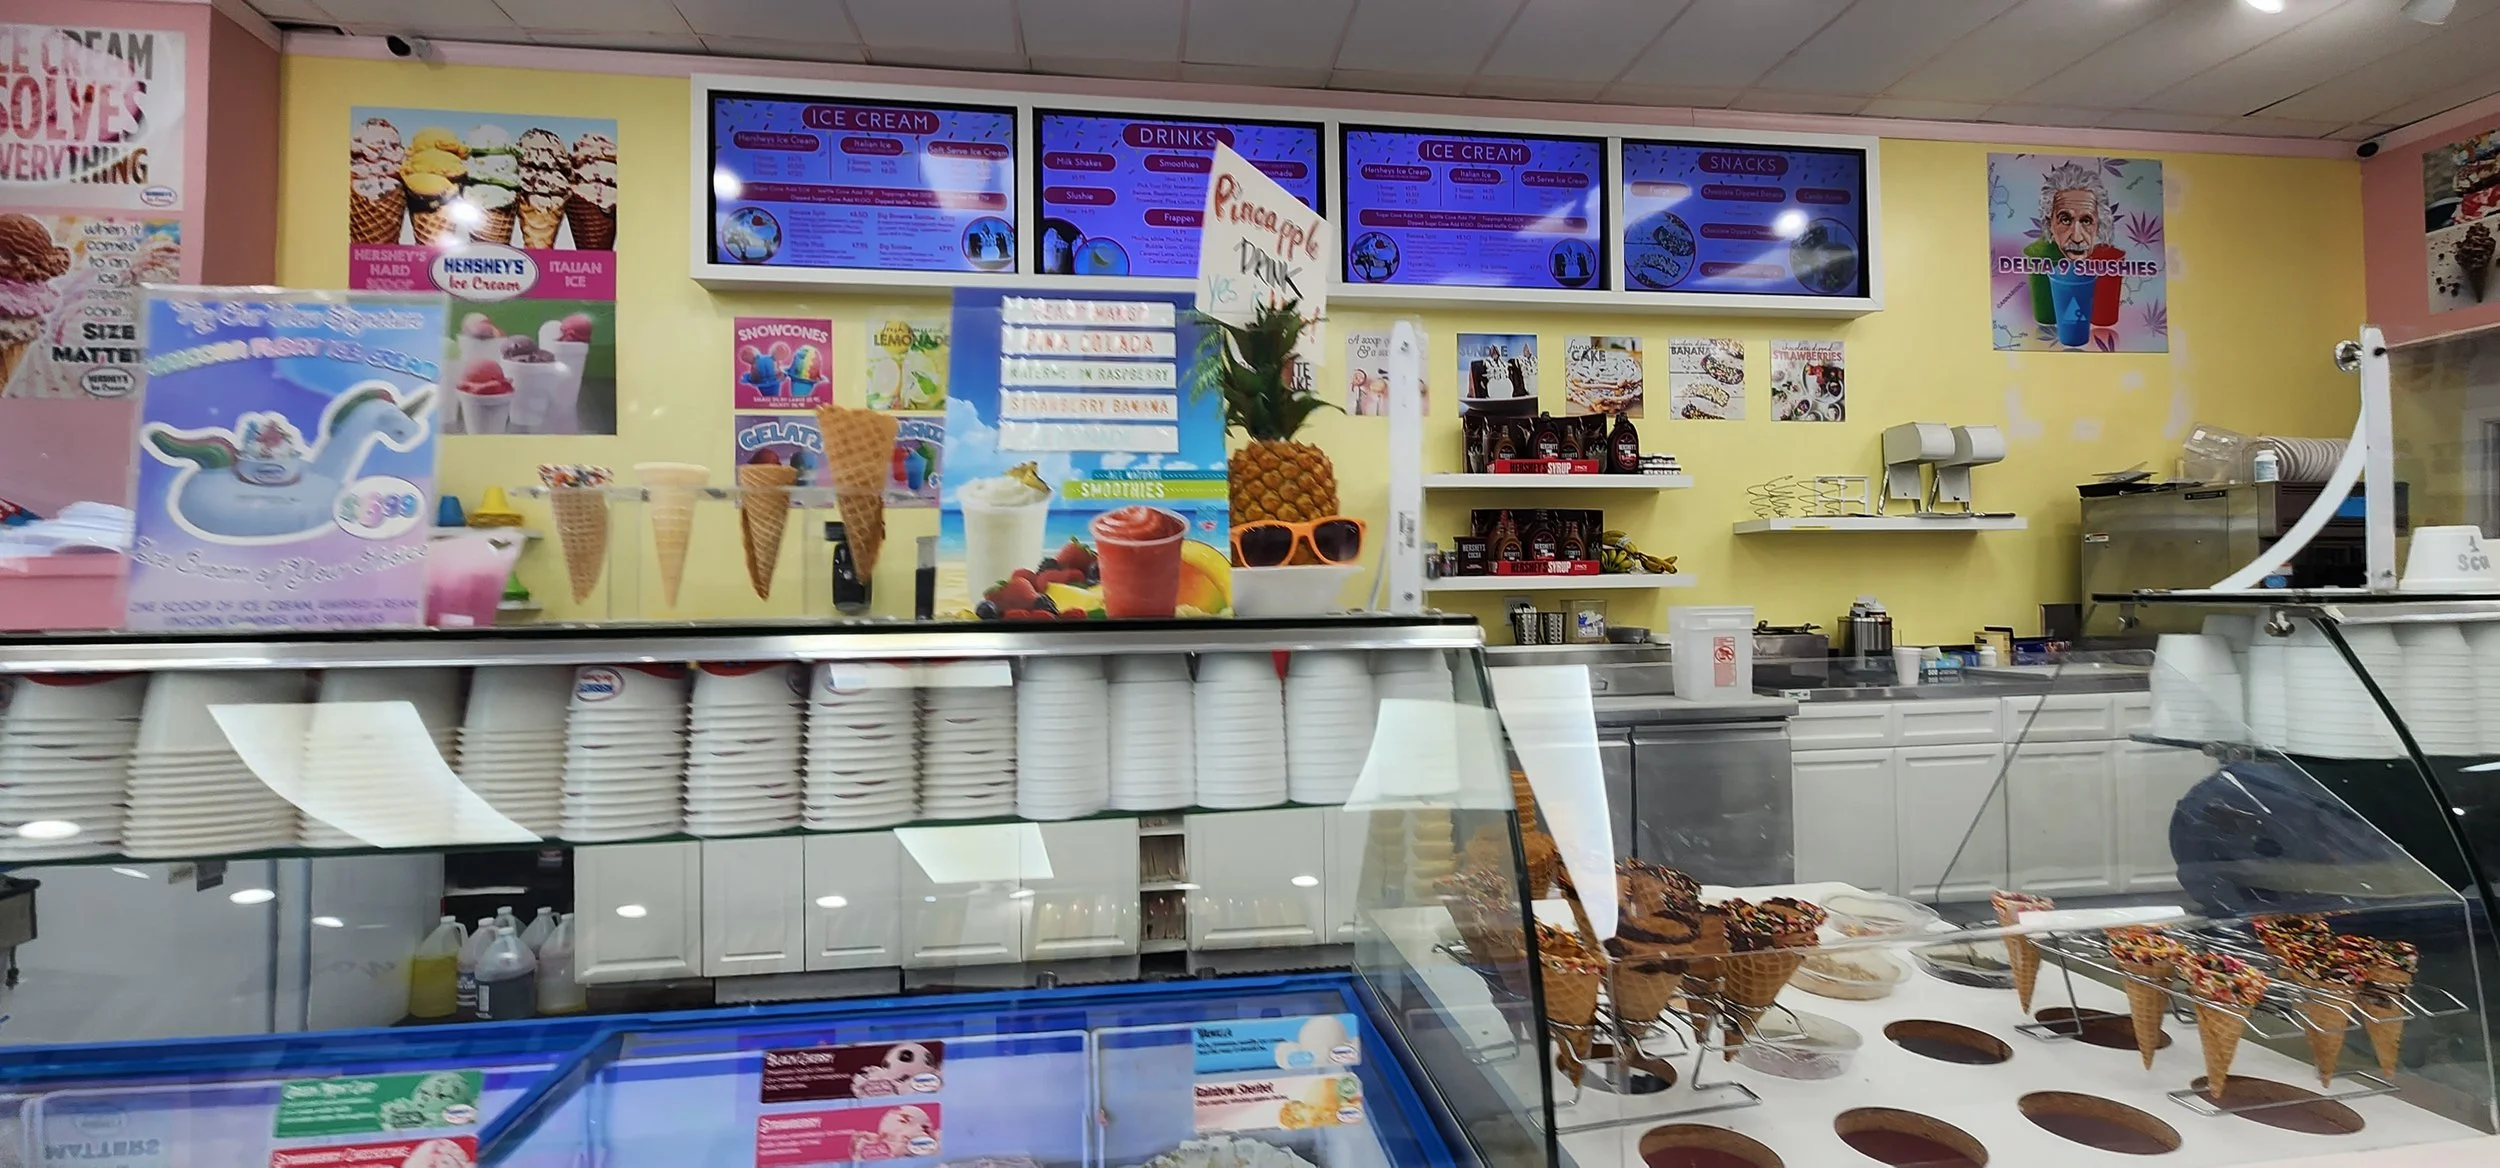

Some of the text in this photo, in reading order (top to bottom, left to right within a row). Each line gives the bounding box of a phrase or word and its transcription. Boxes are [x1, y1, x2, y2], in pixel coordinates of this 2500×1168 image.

[41, 29, 154, 81] CREAM
[812, 109, 928, 131] ICE CREAM
[790, 137, 817, 145] Cream
[1140, 127, 1217, 146] DRINKS
[854, 139, 879, 148] Italian
[984, 149, 1008, 157] Cream
[1426, 143, 1522, 161] ICE CREAM
[1056, 157, 1103, 167] Milk Shakes
[1159, 159, 1199, 169] Smoothies
[1710, 155, 1777, 172] SNACKS
[1264, 169, 1293, 177] monade
[1396, 167, 1407, 175] Ice
[1407, 168, 1430, 176] Cream
[1460, 169, 1481, 178] Italian
[1522, 174, 1536, 182] Soft
[1066, 190, 1094, 200] Slushie
[1703, 186, 1734, 197] Chocolate
[86, 240, 137, 252] comes
[88, 256, 130, 268] to an
[354, 249, 427, 263] HERSHEY'S
[370, 264, 411, 276] HARD
[443, 257, 525, 276] HERSHEY'S
[549, 260, 603, 275] ITALIAN
[1999, 256, 2158, 277] DELTA 9 SLUSHIES
[448, 275, 522, 292] Ice Cream
[565, 275, 587, 288] ICE
[82, 322, 136, 341] SIZE
[737, 323, 829, 344] SNOWCONES
[1459, 344, 1508, 358] SUNDE
[1571, 350, 1606, 362] CAKE
[1772, 350, 1843, 362] STRAWBERRIES
[1112, 399, 1170, 415] BANANA
[1547, 461, 1572, 475] SYRUP
[1080, 481, 1166, 499] SMOOTHIES
[1462, 543, 1486, 552] HERSHEY'S
[1467, 551, 1482, 559] COCOA
[1510, 562, 1548, 574] HERSHEY'S
[1547, 561, 1572, 574] SYRUP
